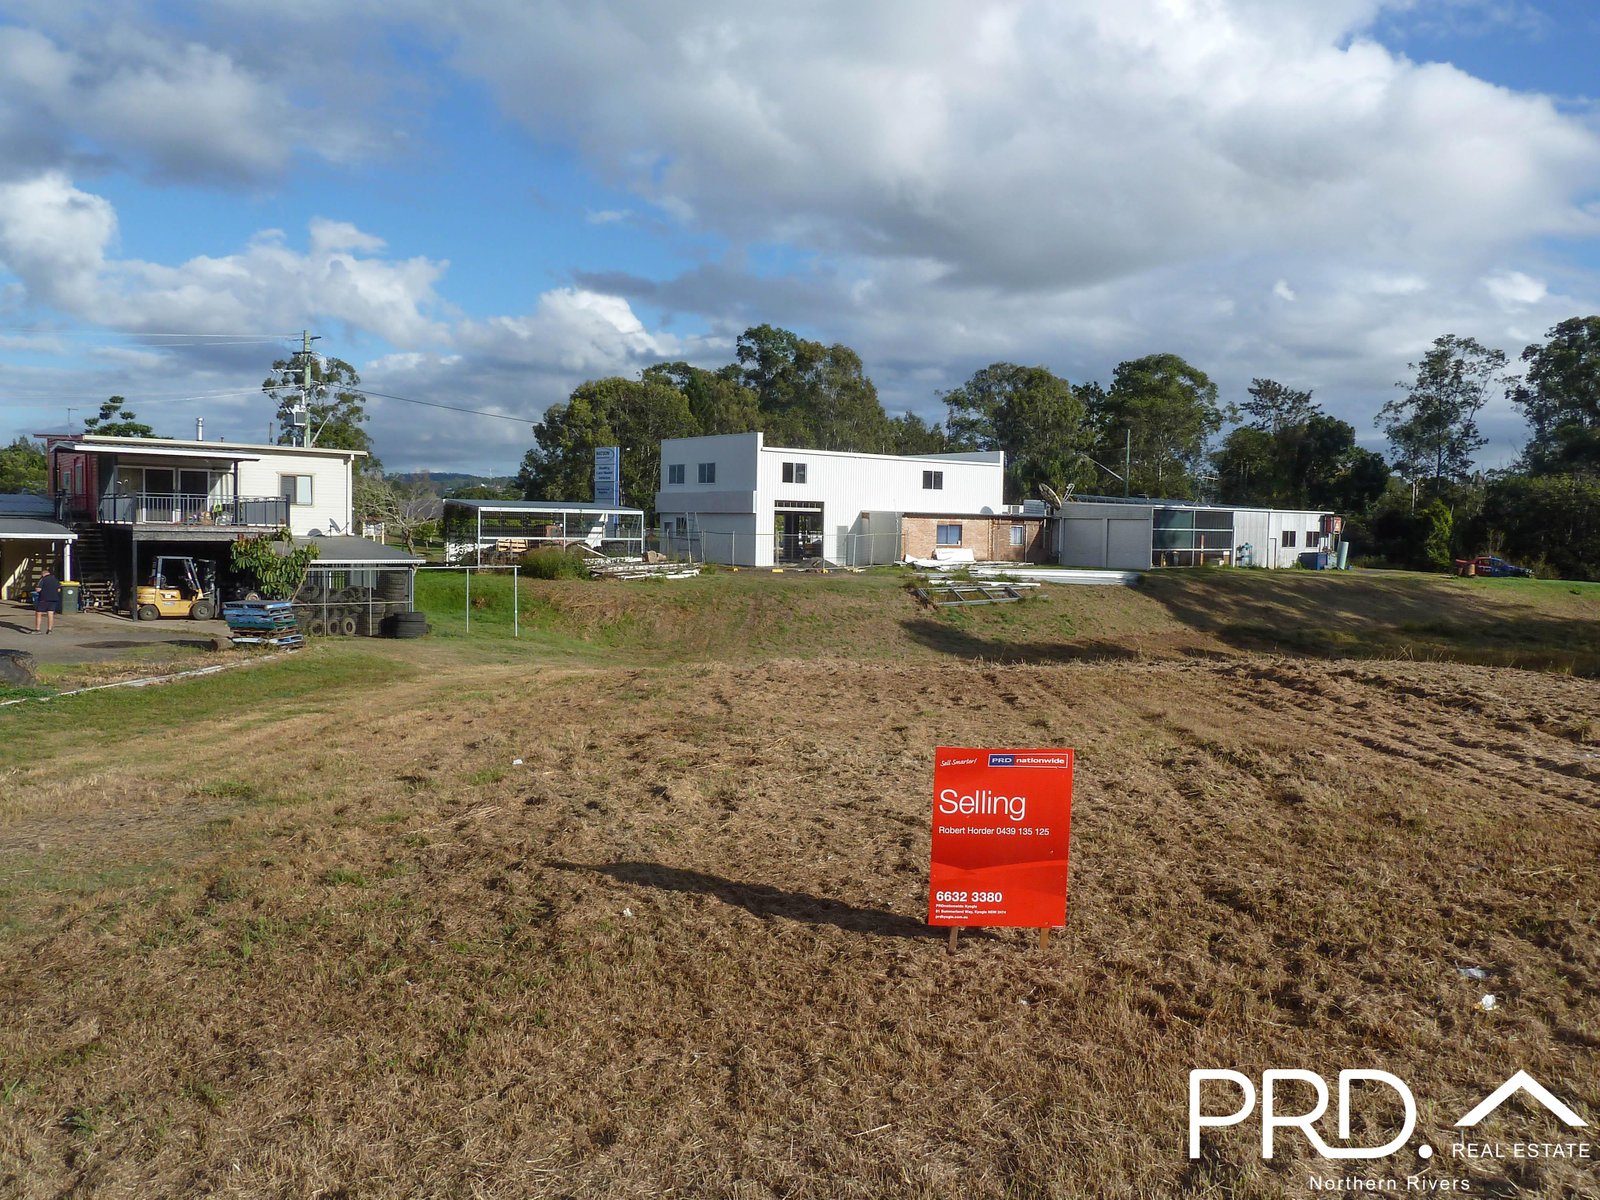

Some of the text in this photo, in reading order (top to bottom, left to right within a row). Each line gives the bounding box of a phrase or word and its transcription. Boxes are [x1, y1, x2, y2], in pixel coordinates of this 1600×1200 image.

[939, 788, 1026, 821] Selling
[938, 826, 1050, 836] Robert Horder 0439 135 125
[936, 891, 1003, 903] 6632 3380
